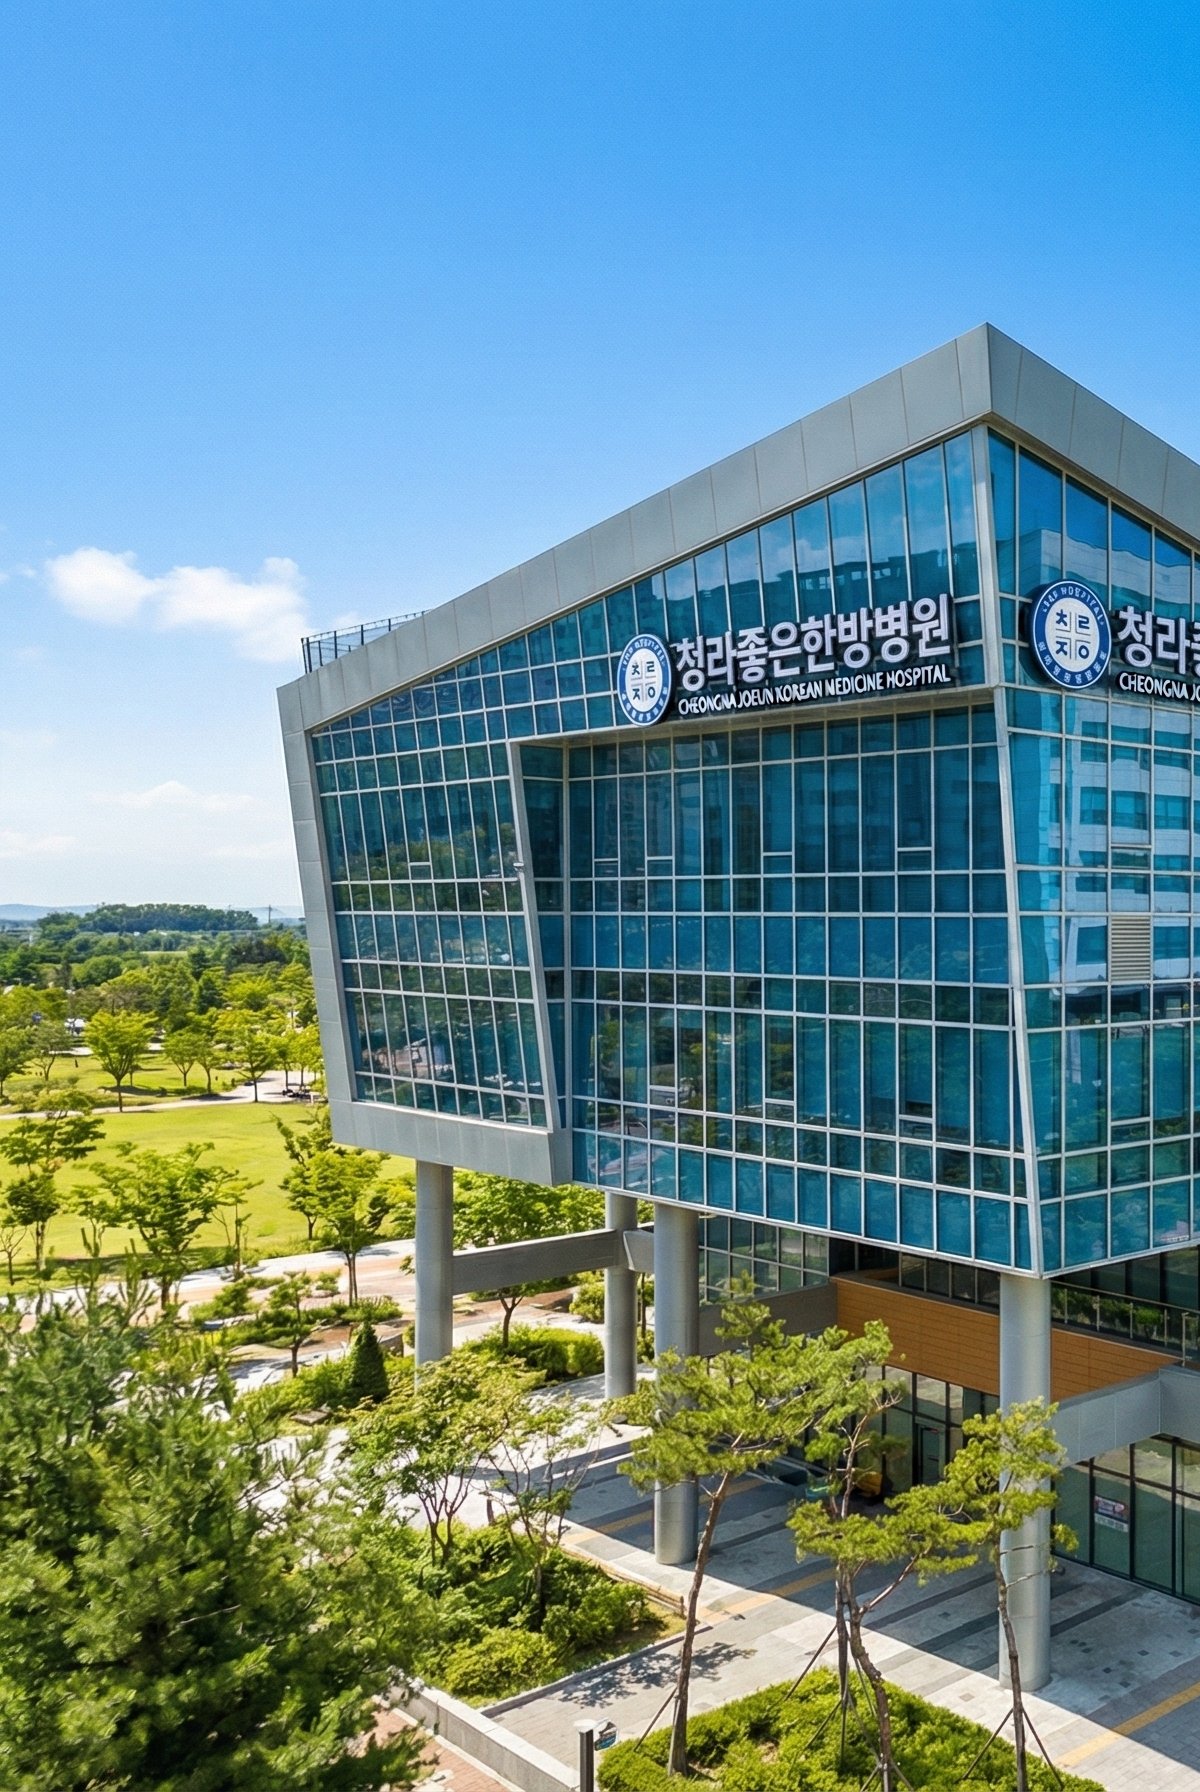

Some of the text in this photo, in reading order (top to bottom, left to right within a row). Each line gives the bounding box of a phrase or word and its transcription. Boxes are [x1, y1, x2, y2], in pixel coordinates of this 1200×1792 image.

[676, 593, 951, 692] 청라좋은한방병원
[774, 680, 823, 703] KOREAN
[886, 663, 952, 689] HOSPITAL
[1119, 672, 1189, 699] CHEONGNA
